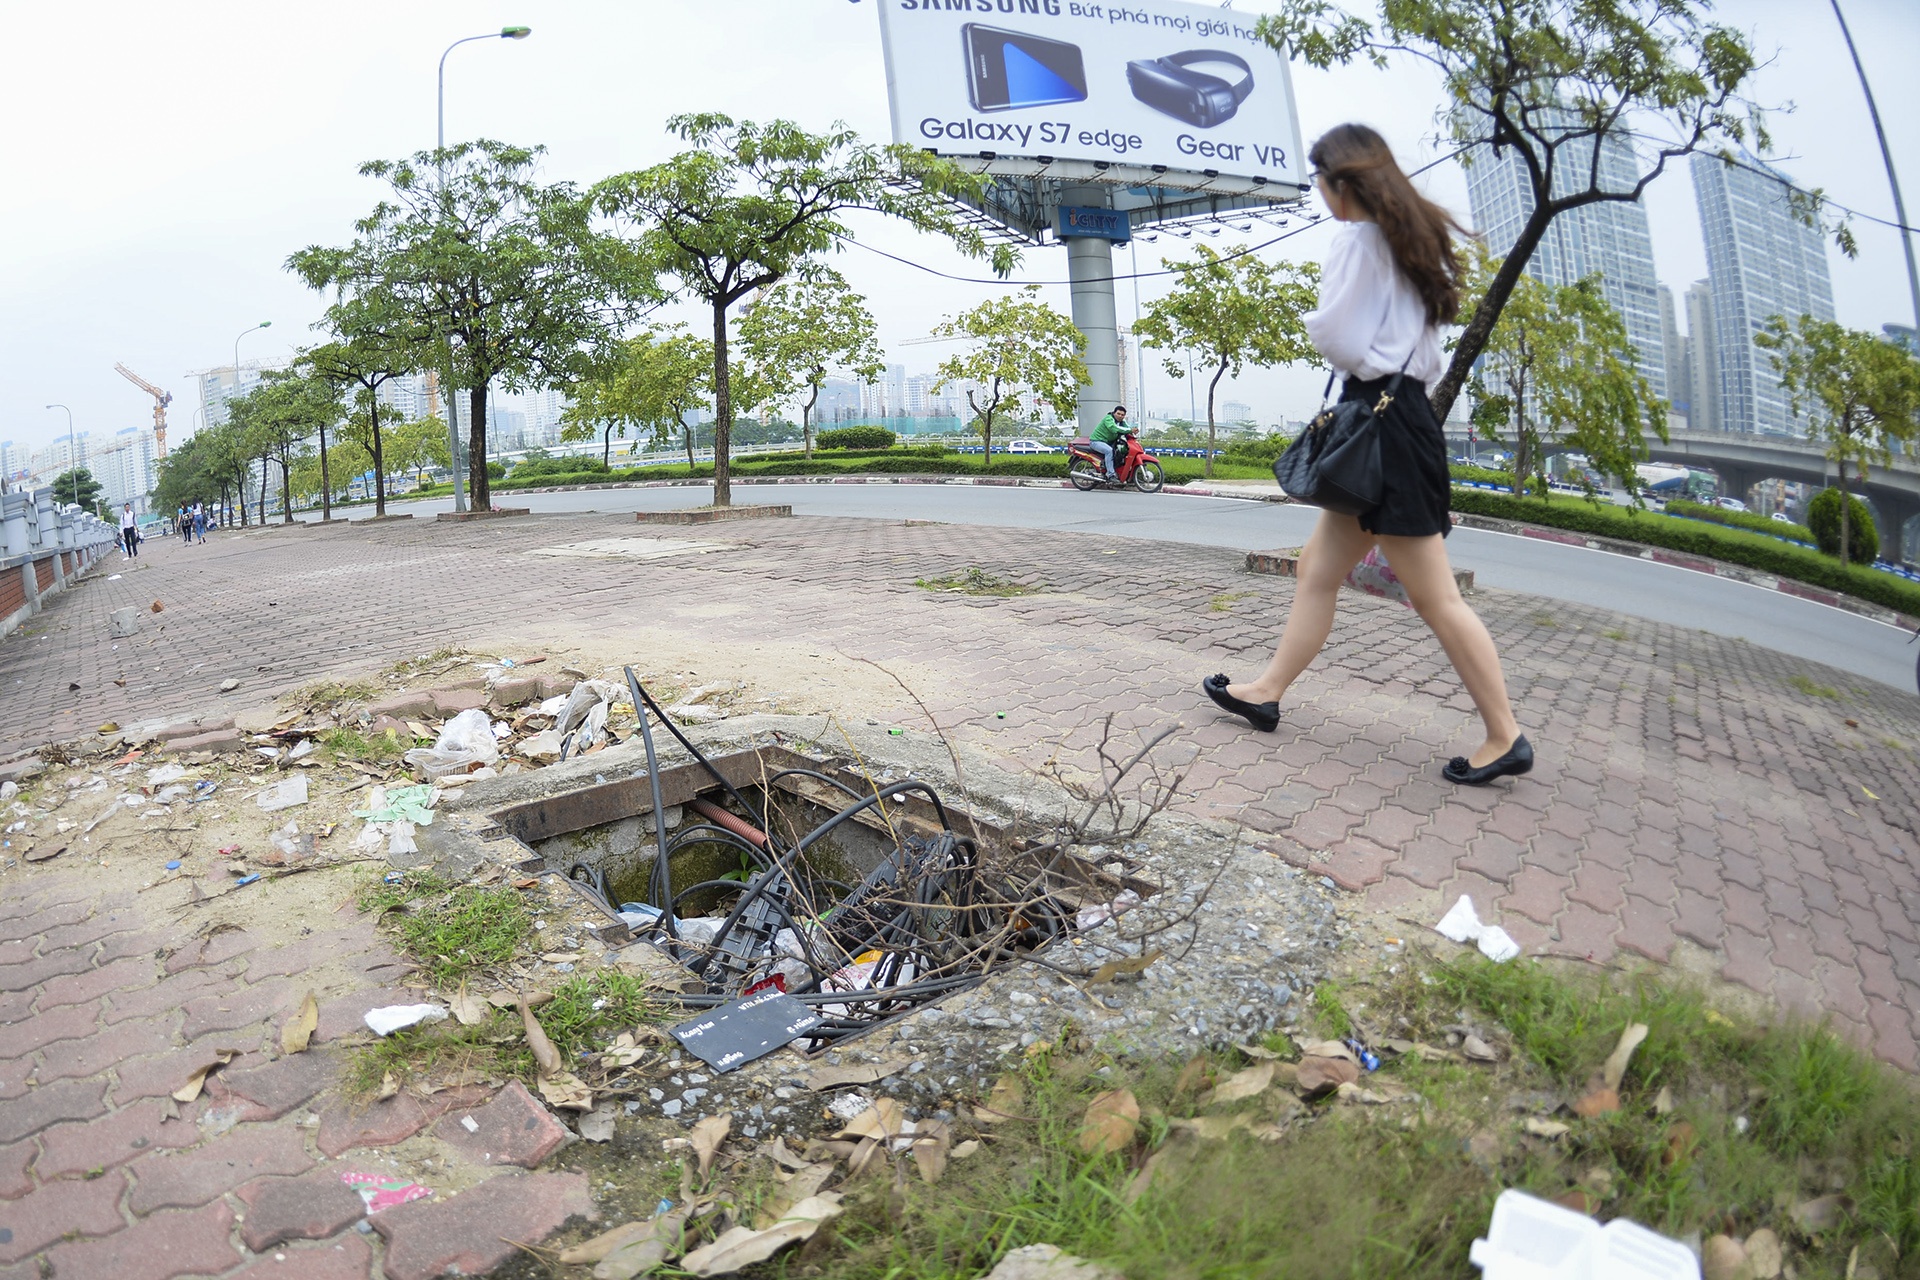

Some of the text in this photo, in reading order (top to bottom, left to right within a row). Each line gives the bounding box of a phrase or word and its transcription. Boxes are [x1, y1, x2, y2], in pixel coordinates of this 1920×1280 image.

[1069, 2, 1104, 19] Bứt
[1108, 8, 1149, 24] phá
[1154, 14, 1191, 33] mọi
[1195, 19, 1230, 37] giới
[919, 117, 1143, 154] Galaxy S7 edge
[1176, 134, 1287, 169] Gear VR
